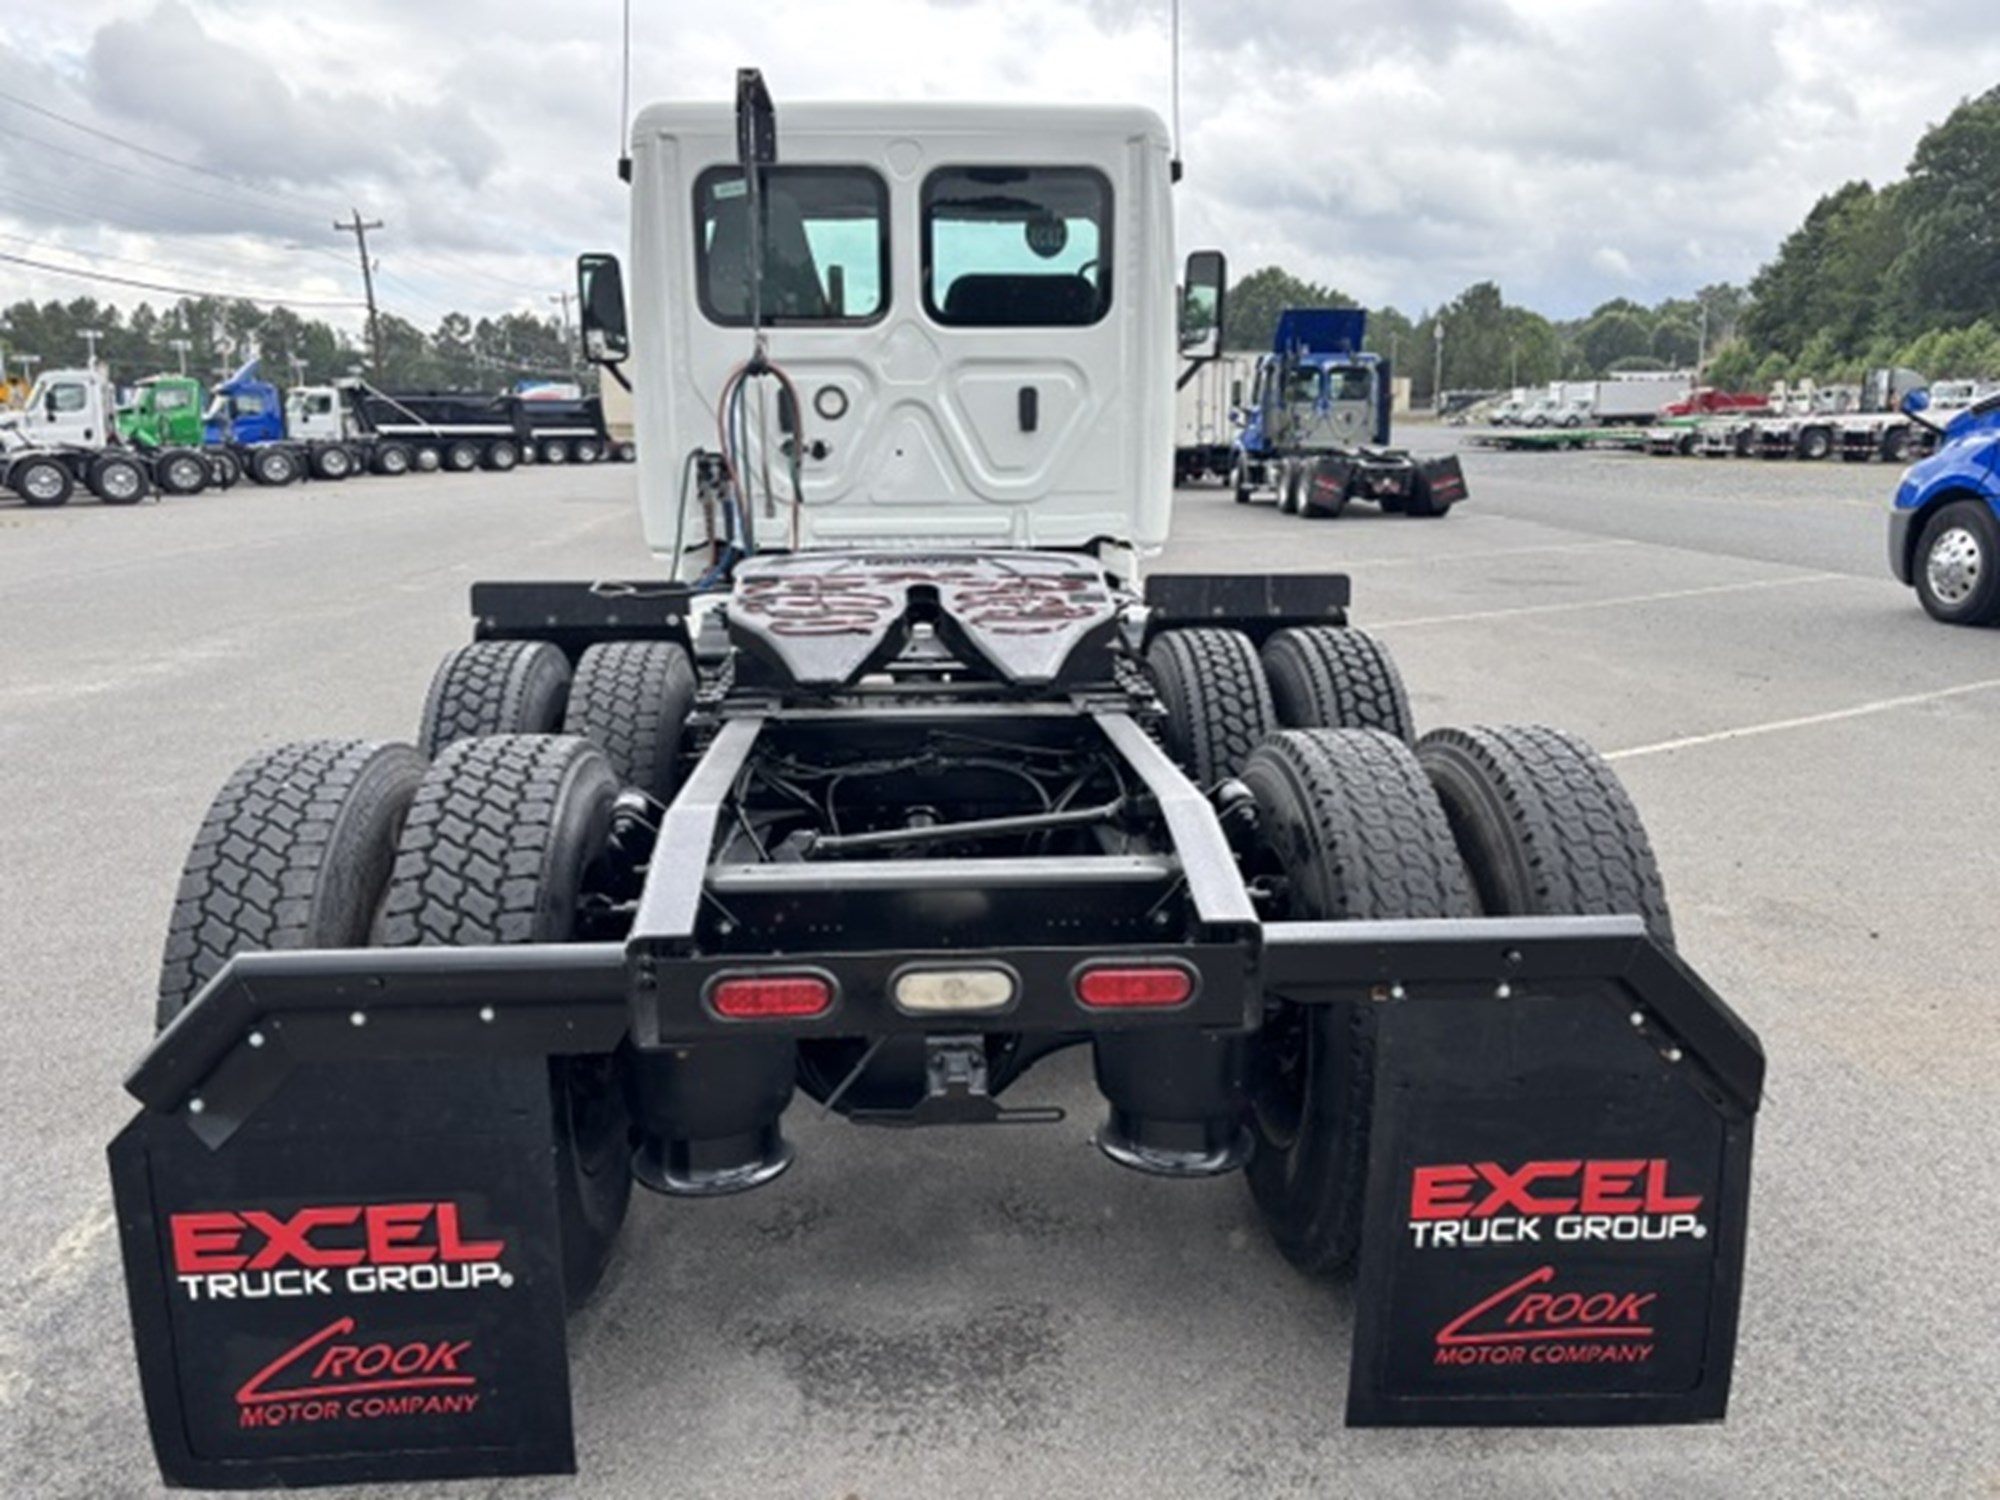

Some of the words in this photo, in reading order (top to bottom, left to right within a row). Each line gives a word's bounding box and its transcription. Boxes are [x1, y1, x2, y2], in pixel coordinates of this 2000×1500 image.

[1410, 1159, 1702, 1219] EXCEL
[170, 1202, 504, 1272] EXCEL
[1409, 1216, 1541, 1248] TRUCK
[177, 1268, 332, 1300] TRUCK
[1436, 1267, 1657, 1344] CROOK
[236, 1317, 476, 1403] CROOK
[1434, 1345, 1526, 1365] MOTOR
[1531, 1343, 1653, 1364] COMPANY
[239, 1400, 341, 1428] MOTOR
[346, 1393, 480, 1420] COMPANY
